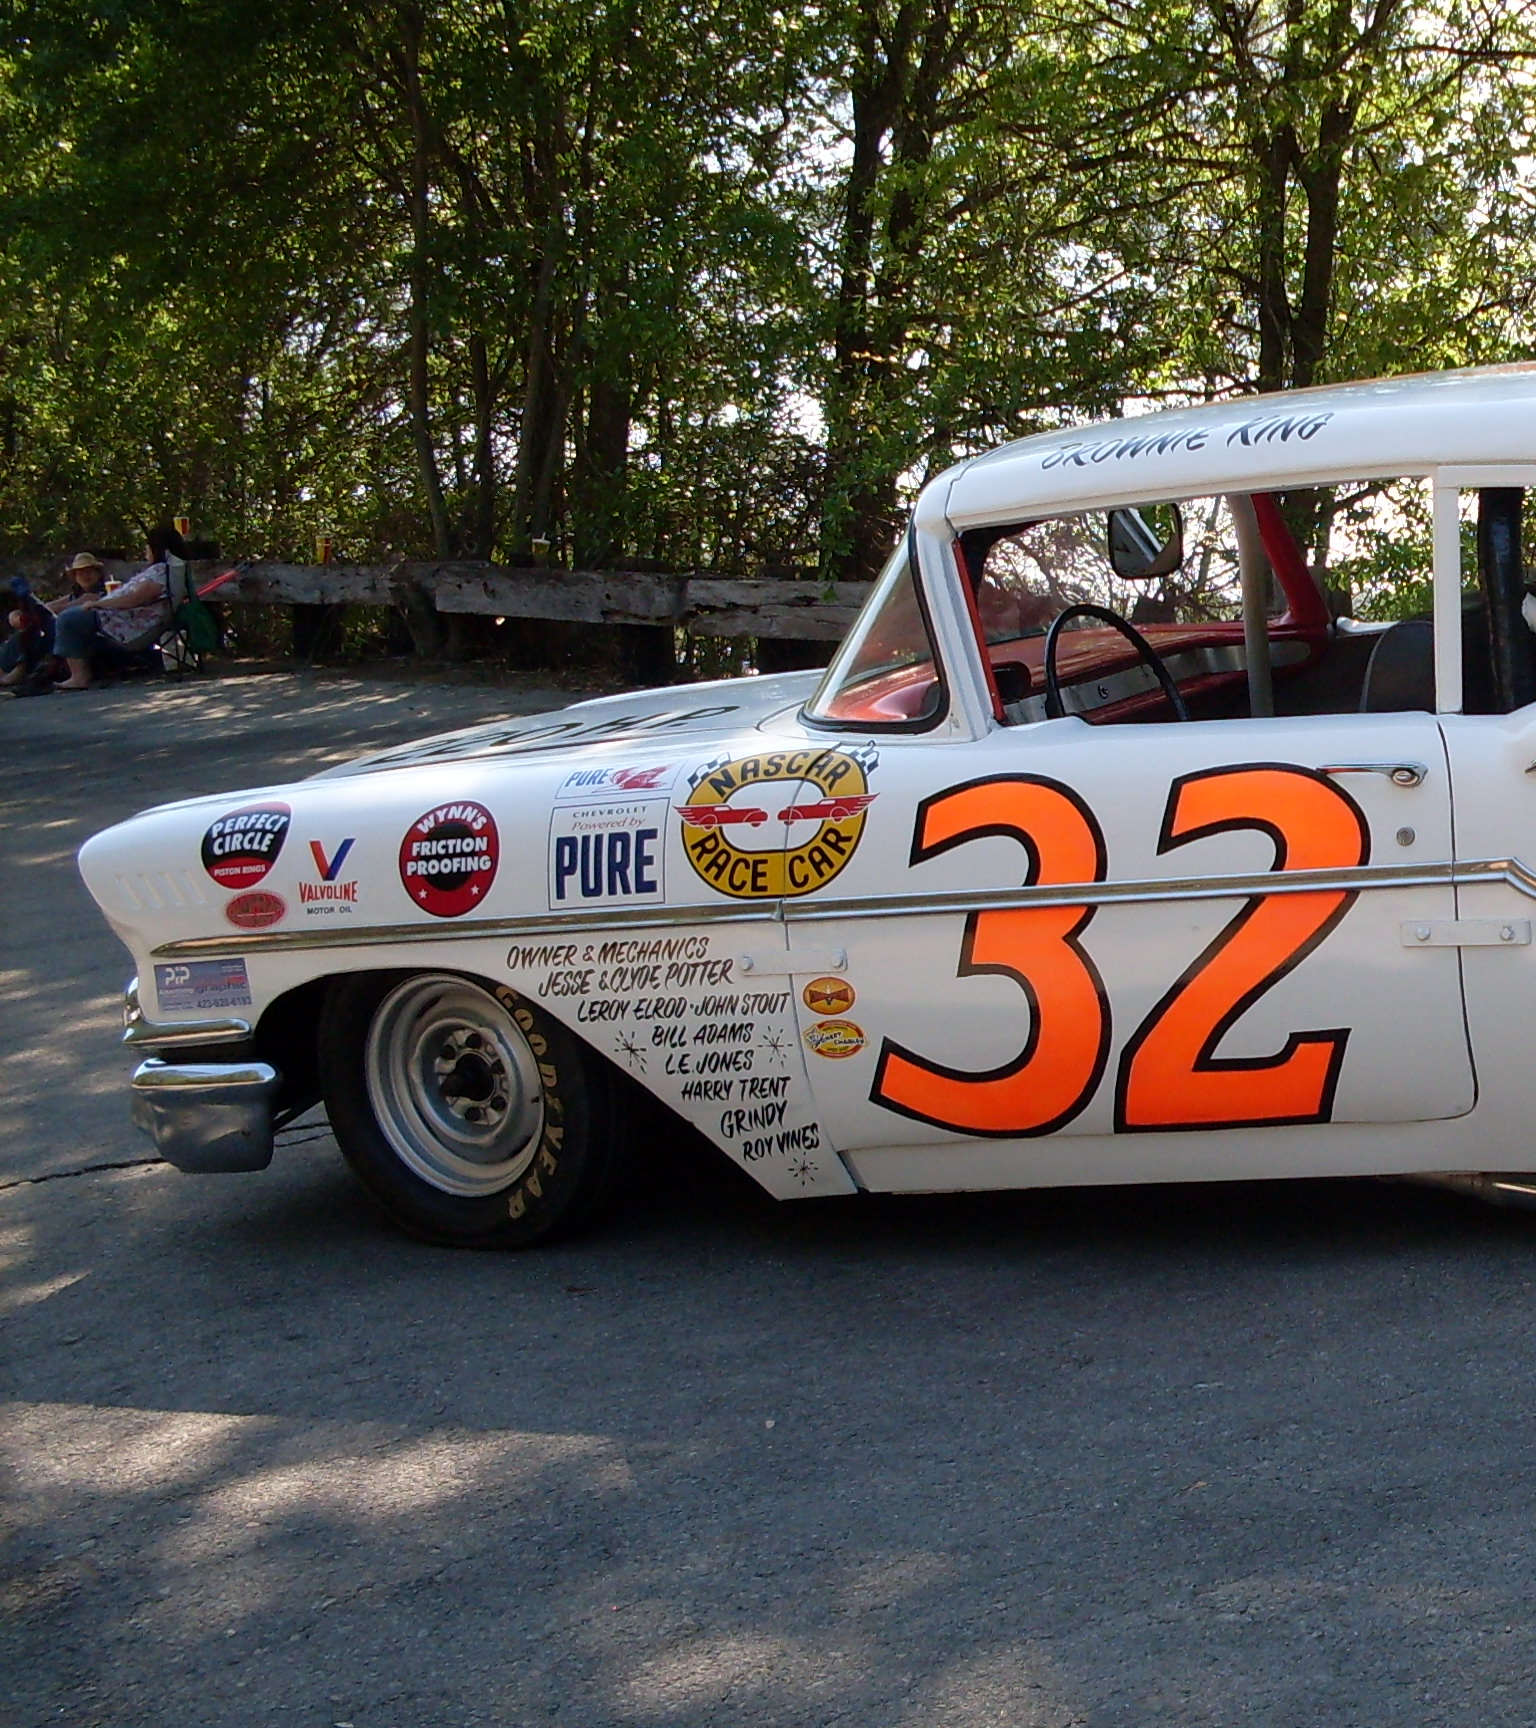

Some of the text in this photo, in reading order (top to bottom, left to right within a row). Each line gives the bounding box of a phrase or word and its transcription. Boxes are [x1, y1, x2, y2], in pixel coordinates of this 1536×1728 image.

[1041, 412, 1335, 470] BROWNIE KING
[564, 767, 614, 788] PURE
[708, 751, 852, 799] NASCAR
[416, 804, 488, 834] WYNN'S
[572, 805, 648, 818] CHEVROLET
[572, 816, 647, 831] Powered by
[212, 813, 289, 839] PERFECT
[213, 832, 275, 856] CIRCLE
[411, 836, 488, 857] FRICTION
[214, 864, 266, 877] PISTON RINGS
[406, 856, 492, 877] PROOFING
[555, 828, 659, 900] PURE
[690, 827, 854, 892] RACE CAR
[298, 881, 358, 903] VALVOLINE
[306, 906, 353, 915] MOTOR OIL
[506, 936, 711, 970] OWNER & MECHANICS
[869, 761, 1372, 1139] 32
[538, 969, 596, 998] JESSE
[664, 958, 735, 989] POTTER
[577, 999, 628, 1023] LEROY
[741, 992, 791, 1015] STOUT
[651, 1022, 755, 1048] BILL ADAMS
[680, 1075, 791, 1102] HARRY TRENT
[720, 1100, 788, 1139] GRINDY
[741, 1122, 820, 1162] ROY VINES
